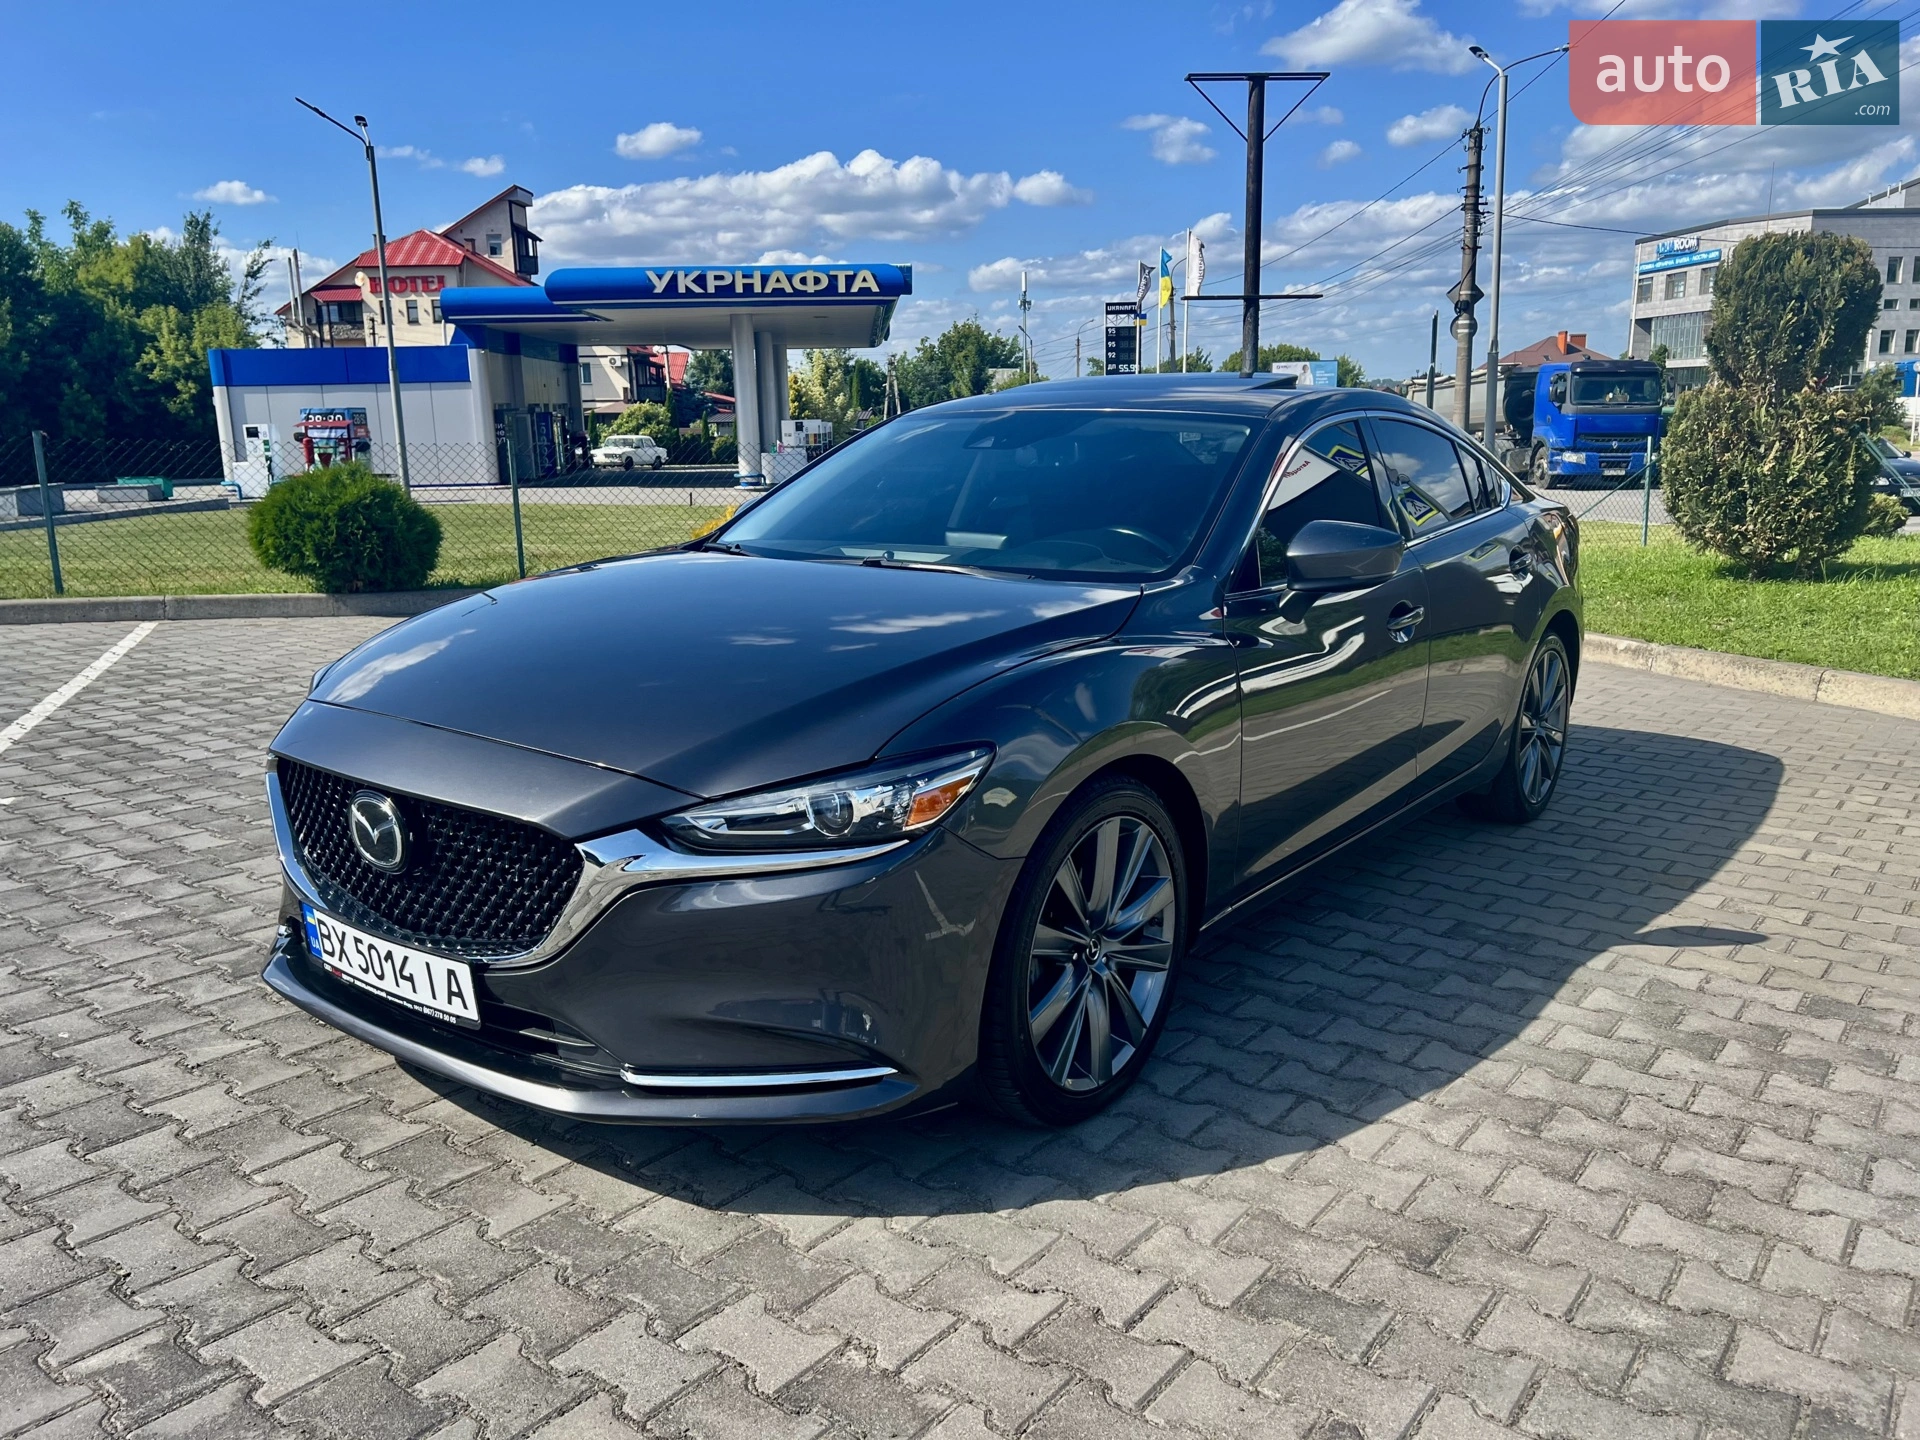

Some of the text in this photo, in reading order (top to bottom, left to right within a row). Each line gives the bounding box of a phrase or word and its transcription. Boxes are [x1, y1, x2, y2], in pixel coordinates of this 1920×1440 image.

[646, 269, 880, 293] УКРНАФТА
[310, 937, 321, 951] UA
[317, 917, 354, 968] BX
[353, 935, 418, 995] 5014
[425, 961, 469, 1011] IA
